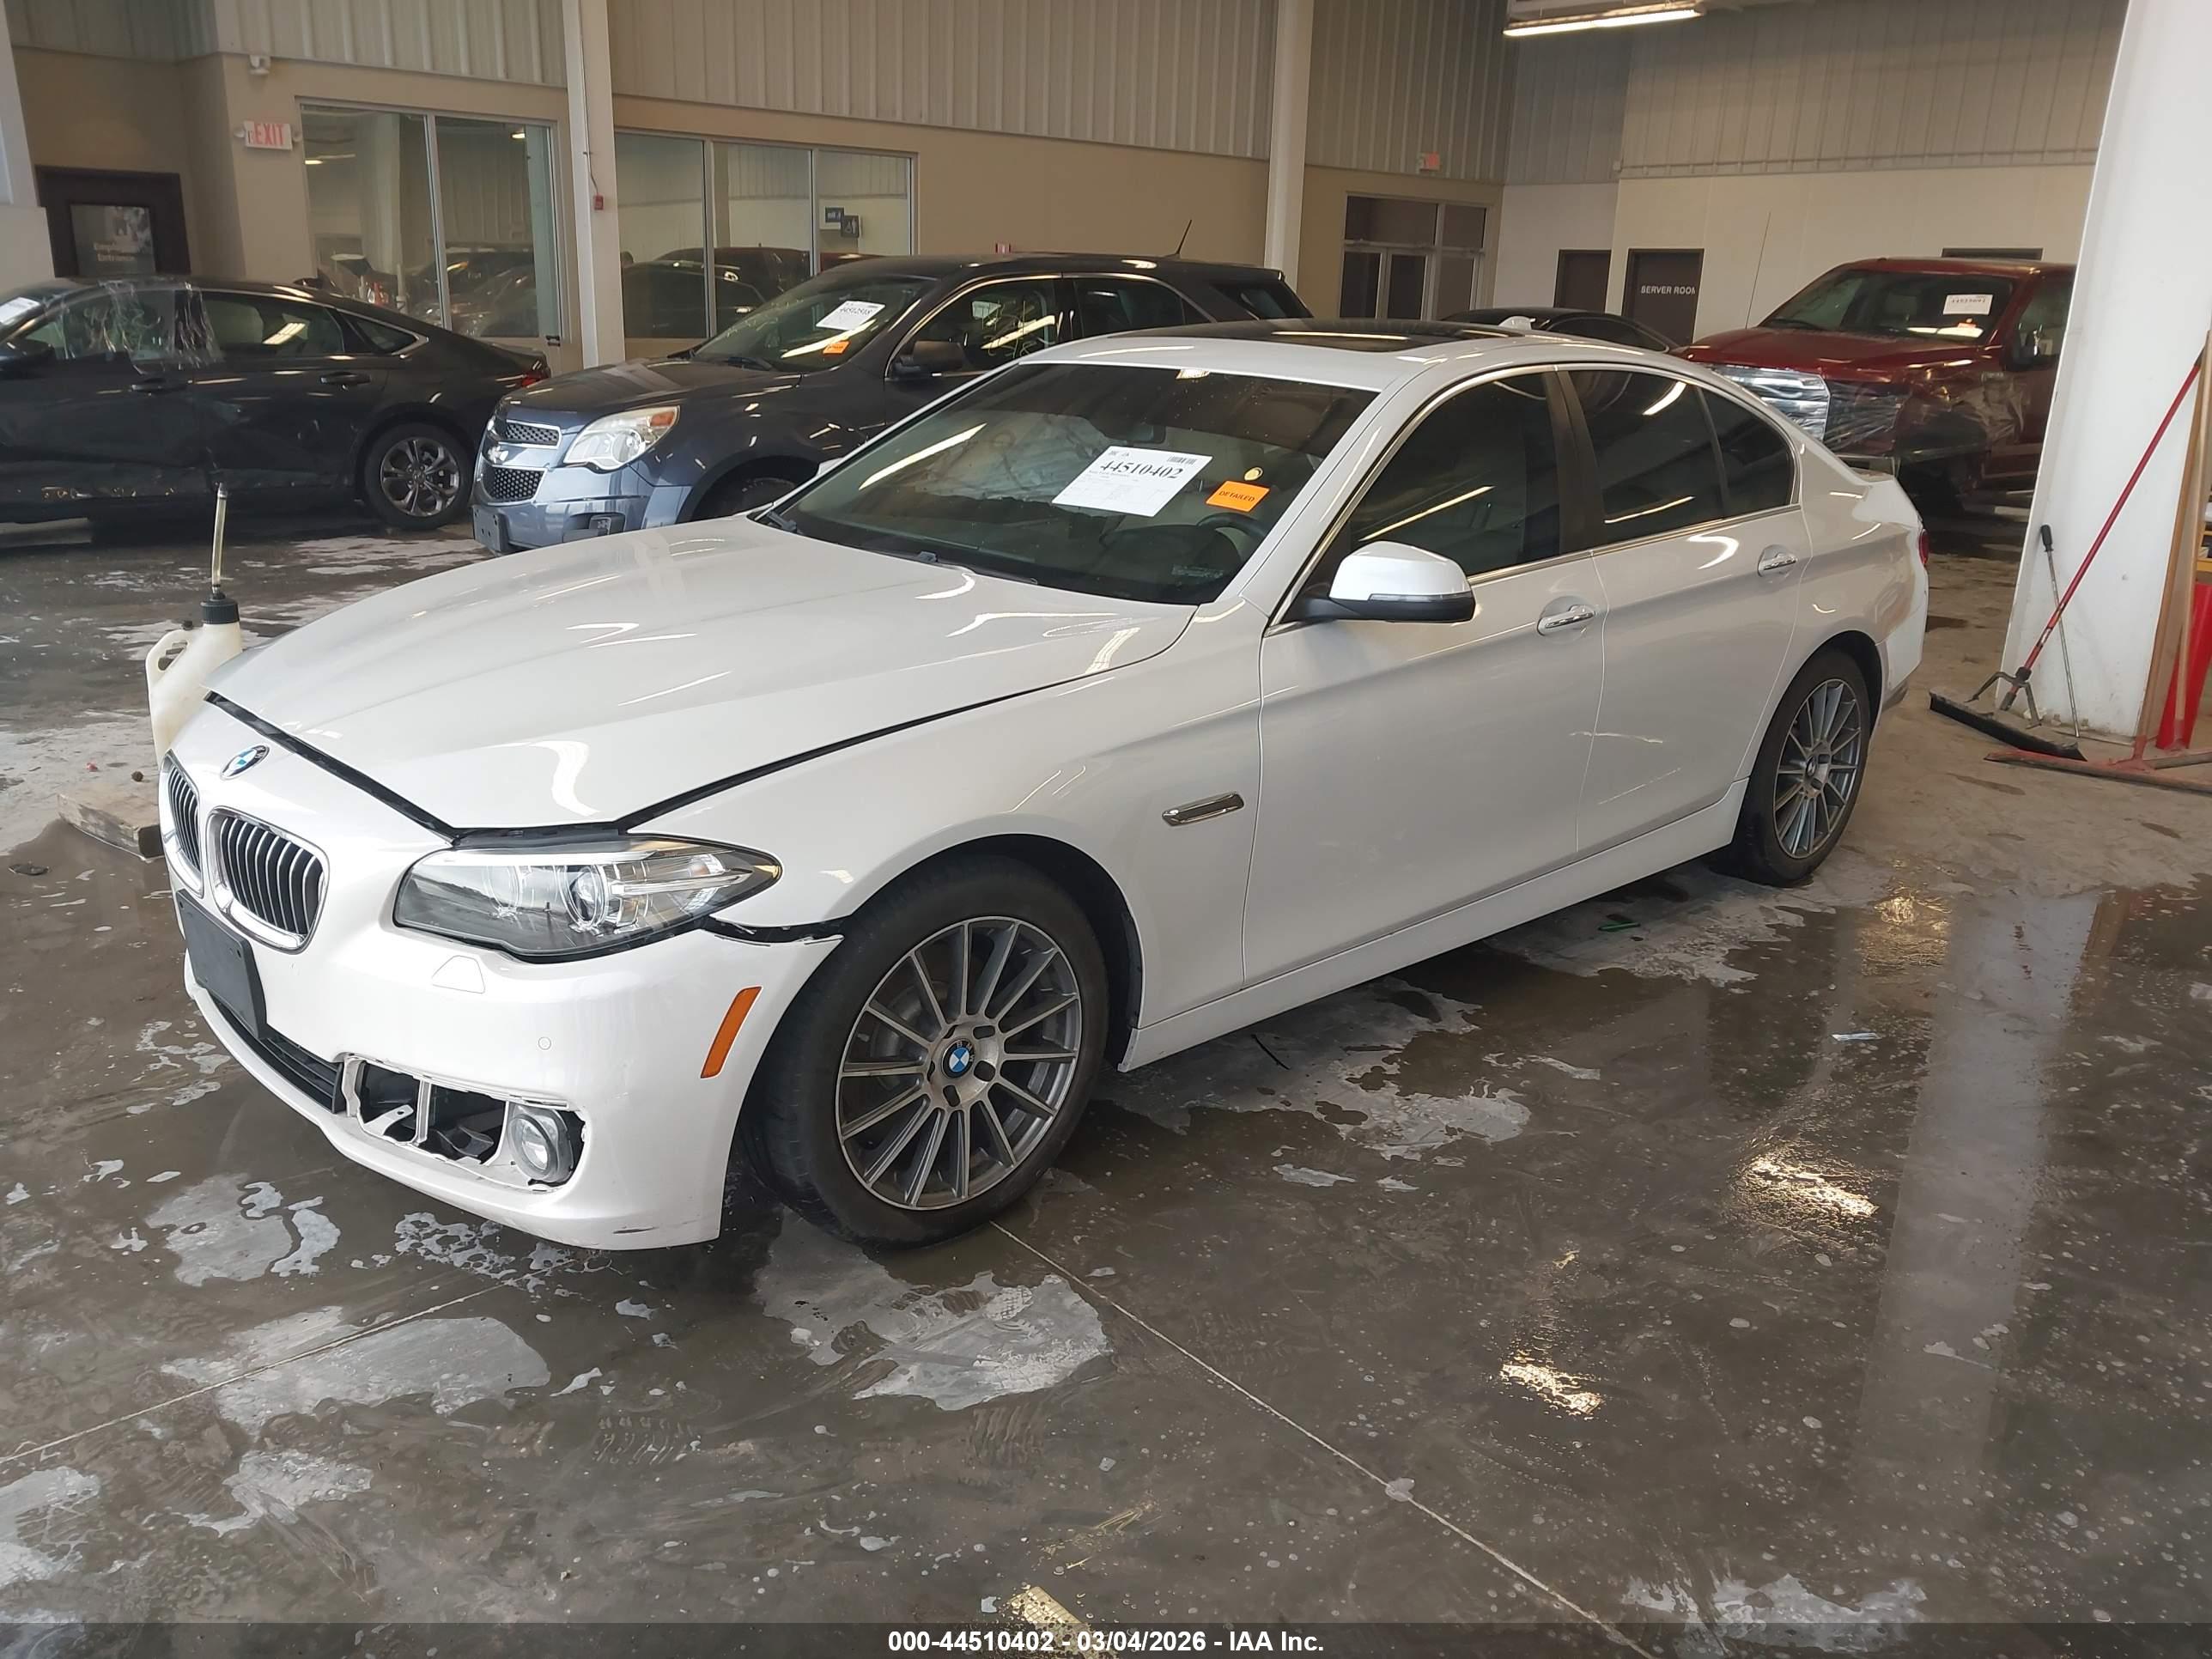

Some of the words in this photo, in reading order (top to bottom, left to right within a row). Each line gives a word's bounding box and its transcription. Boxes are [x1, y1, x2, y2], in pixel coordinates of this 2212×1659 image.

[254, 123, 284, 145] EXIT
[1641, 285, 1672, 295] SERVER
[1099, 459, 1184, 479] 44510402
[1218, 489, 1255, 502] DETAILED
